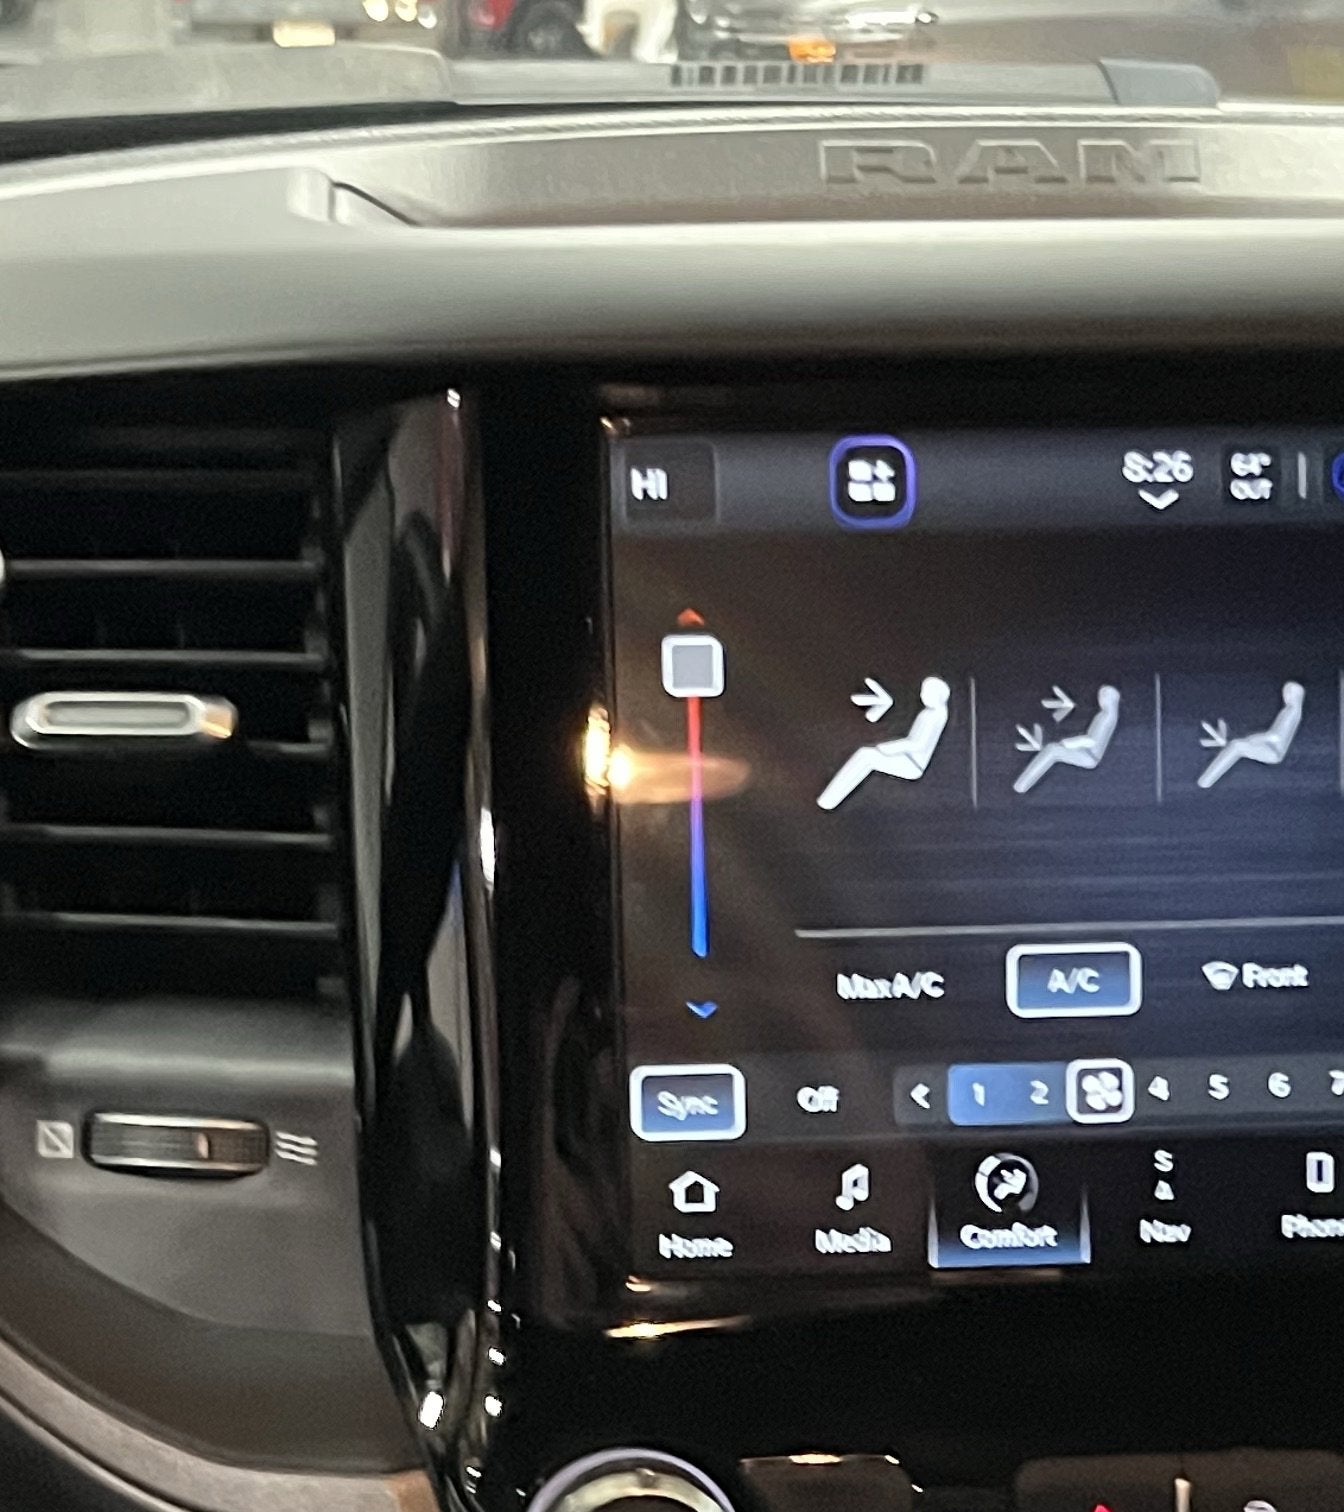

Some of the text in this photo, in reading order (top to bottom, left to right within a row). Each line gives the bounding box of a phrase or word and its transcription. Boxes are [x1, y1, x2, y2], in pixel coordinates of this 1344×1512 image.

[819, 139, 1202, 185] RAM
[630, 468, 668, 501] HI
[893, 970, 944, 998] A/C
[1047, 967, 1100, 993] A/C
[1241, 962, 1309, 990] Front
[796, 1086, 840, 1113] Off
[972, 1081, 986, 1106] 1
[1029, 1079, 1050, 1105] 2
[1147, 1076, 1171, 1101] 4
[1207, 1073, 1231, 1100] 5
[1267, 1072, 1292, 1098] 6
[657, 1090, 720, 1121] Sync
[815, 1226, 892, 1254] Media
[959, 1221, 1058, 1250] Comfort
[1139, 1218, 1192, 1243] Nav
[658, 1232, 734, 1260] Home
